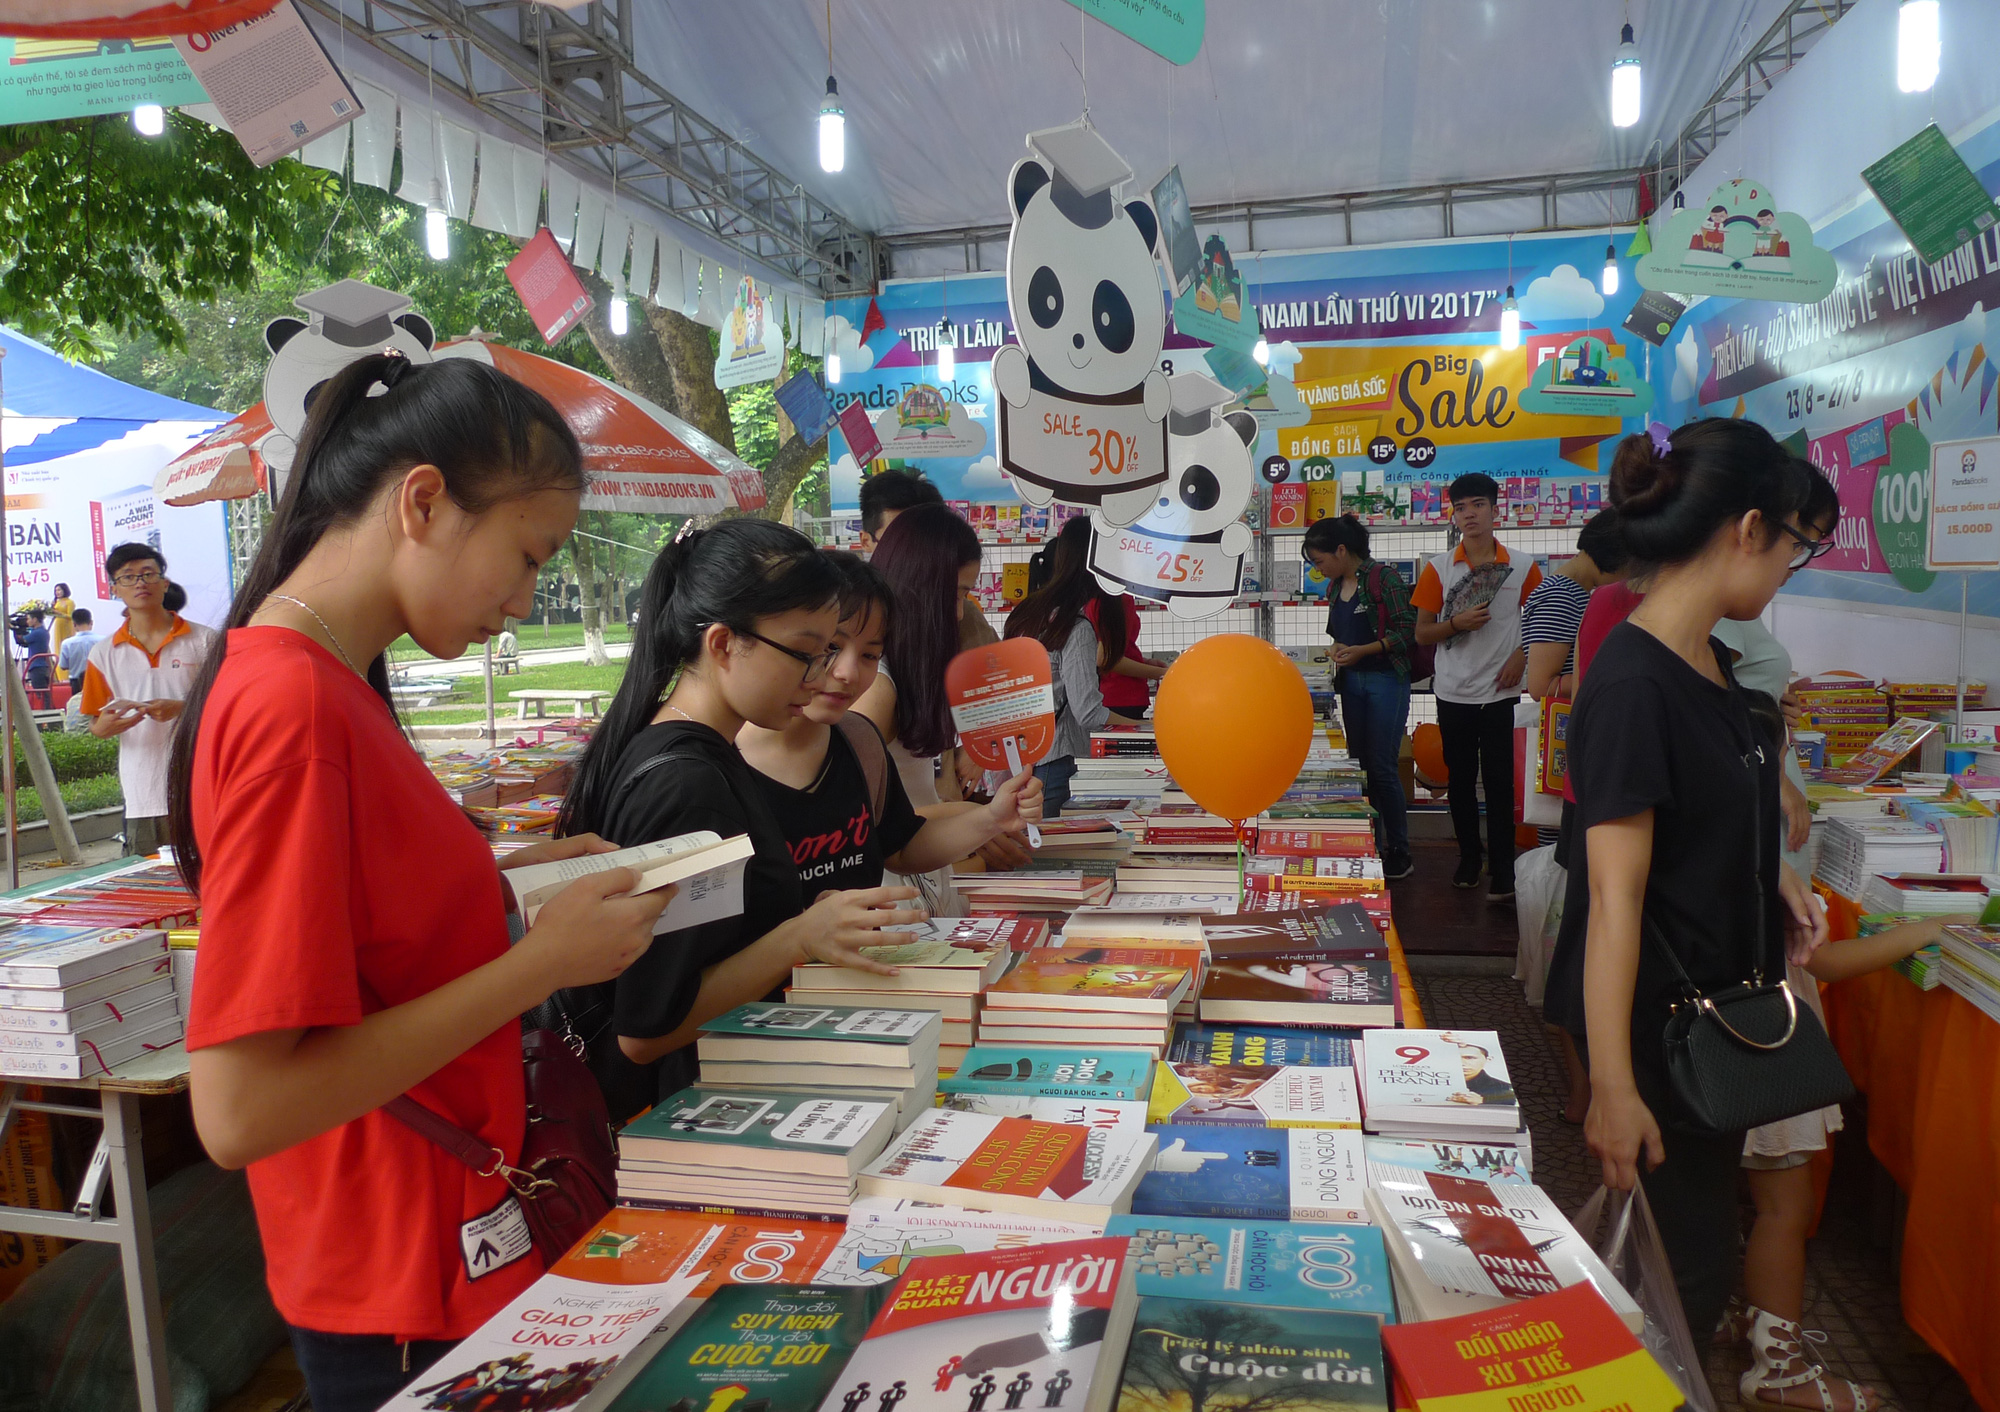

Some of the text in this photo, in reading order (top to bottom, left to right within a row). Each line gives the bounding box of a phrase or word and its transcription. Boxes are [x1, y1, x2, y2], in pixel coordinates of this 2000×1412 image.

[187, 24, 239, 52] Oliver
[155, 60, 174, 73] gieo
[73, 82, 82, 92] ta
[84, 80, 104, 93] gieo
[122, 76, 147, 89] trong
[87, 92, 154, 106] MANN HORACE
[1262, 303, 1308, 329] NAM
[1314, 291, 1353, 326] LẦN
[1359, 291, 1400, 324] THỨ
[1404, 294, 1424, 320] VI
[963, 318, 1003, 347] LÃM
[1434, 354, 1467, 375] Big
[1307, 375, 1386, 405] VÀNG GIÁ SỐC
[1396, 358, 1515, 437] Sale
[1043, 413, 1083, 437] SALE
[1334, 423, 1358, 436] SÁCH
[1086, 428, 1139, 475] 30%
[1291, 436, 1362, 456] ĐỒNG GIÁ
[1371, 443, 1434, 462] 15K 20K
[1127, 463, 1139, 472] OFF
[1269, 463, 1332, 480] 5K 10K
[1420, 471, 1449, 483] Công
[1522, 467, 1549, 477] Nhất
[1952, 477, 1988, 486] PandaBooks
[129, 504, 154, 516] A WAR
[1935, 503, 1958, 513] SÁCH
[1961, 501, 1984, 512] ĐỒNG
[115, 512, 154, 527] ACCOUNT
[1947, 523, 1992, 534] 15.000Đ
[9, 517, 61, 546] BẢN
[1835, 506, 1869, 570] ặng
[1898, 532, 1918, 547] CHO
[16, 550, 63, 564] TRANH
[1119, 538, 1154, 555] SALE
[1156, 551, 1204, 582] 25%
[786, 803, 869, 864] on't
[841, 854, 863, 868] ME
[1395, 1046, 1430, 1064] 9
[1289, 1074, 1304, 1112] THU PHỤC
[1310, 1075, 1325, 1112] NHÂN TÂM
[982, 1125, 1052, 1190] THÀNH CÔNG
[1035, 1133, 1072, 1166] QUYẾT
[1313, 1131, 1339, 1201] DÙNG NGƯỜI
[1293, 1207, 1328, 1219] NGƯỜI
[1402, 1194, 1539, 1220] LÒNG NGƯỜI
[1248, 1230, 1275, 1292] CẦN HỌC HỎI
[1298, 1232, 1358, 1290] 100
[1478, 1253, 1551, 1275] THẤU
[906, 1273, 972, 1289] BIẾT
[964, 1254, 1116, 1306] NGƯỜI
[1492, 1270, 1558, 1293] NHÌN
[553, 1295, 663, 1311] NGHỆ THUẬT
[763, 1300, 838, 1313] Thay đổi
[520, 1306, 660, 1328] GIAO TIẾP
[731, 1312, 844, 1330] SUY NGHĨ
[511, 1326, 632, 1347] ỨNG XỬ
[738, 1329, 815, 1343] Thay đổi
[1455, 1320, 1564, 1360] ĐỐI NHÂN
[689, 1342, 831, 1368] CUỘC ĐỜI
[1215, 1340, 1234, 1355] lý
[1240, 1343, 1297, 1356] nhân
[1302, 1347, 1351, 1360] sinh
[1179, 1353, 1374, 1386] Cuộc đời
[1478, 1343, 1572, 1387] XỬ THẾ
[1507, 1381, 1586, 1412] NGƯỜI
